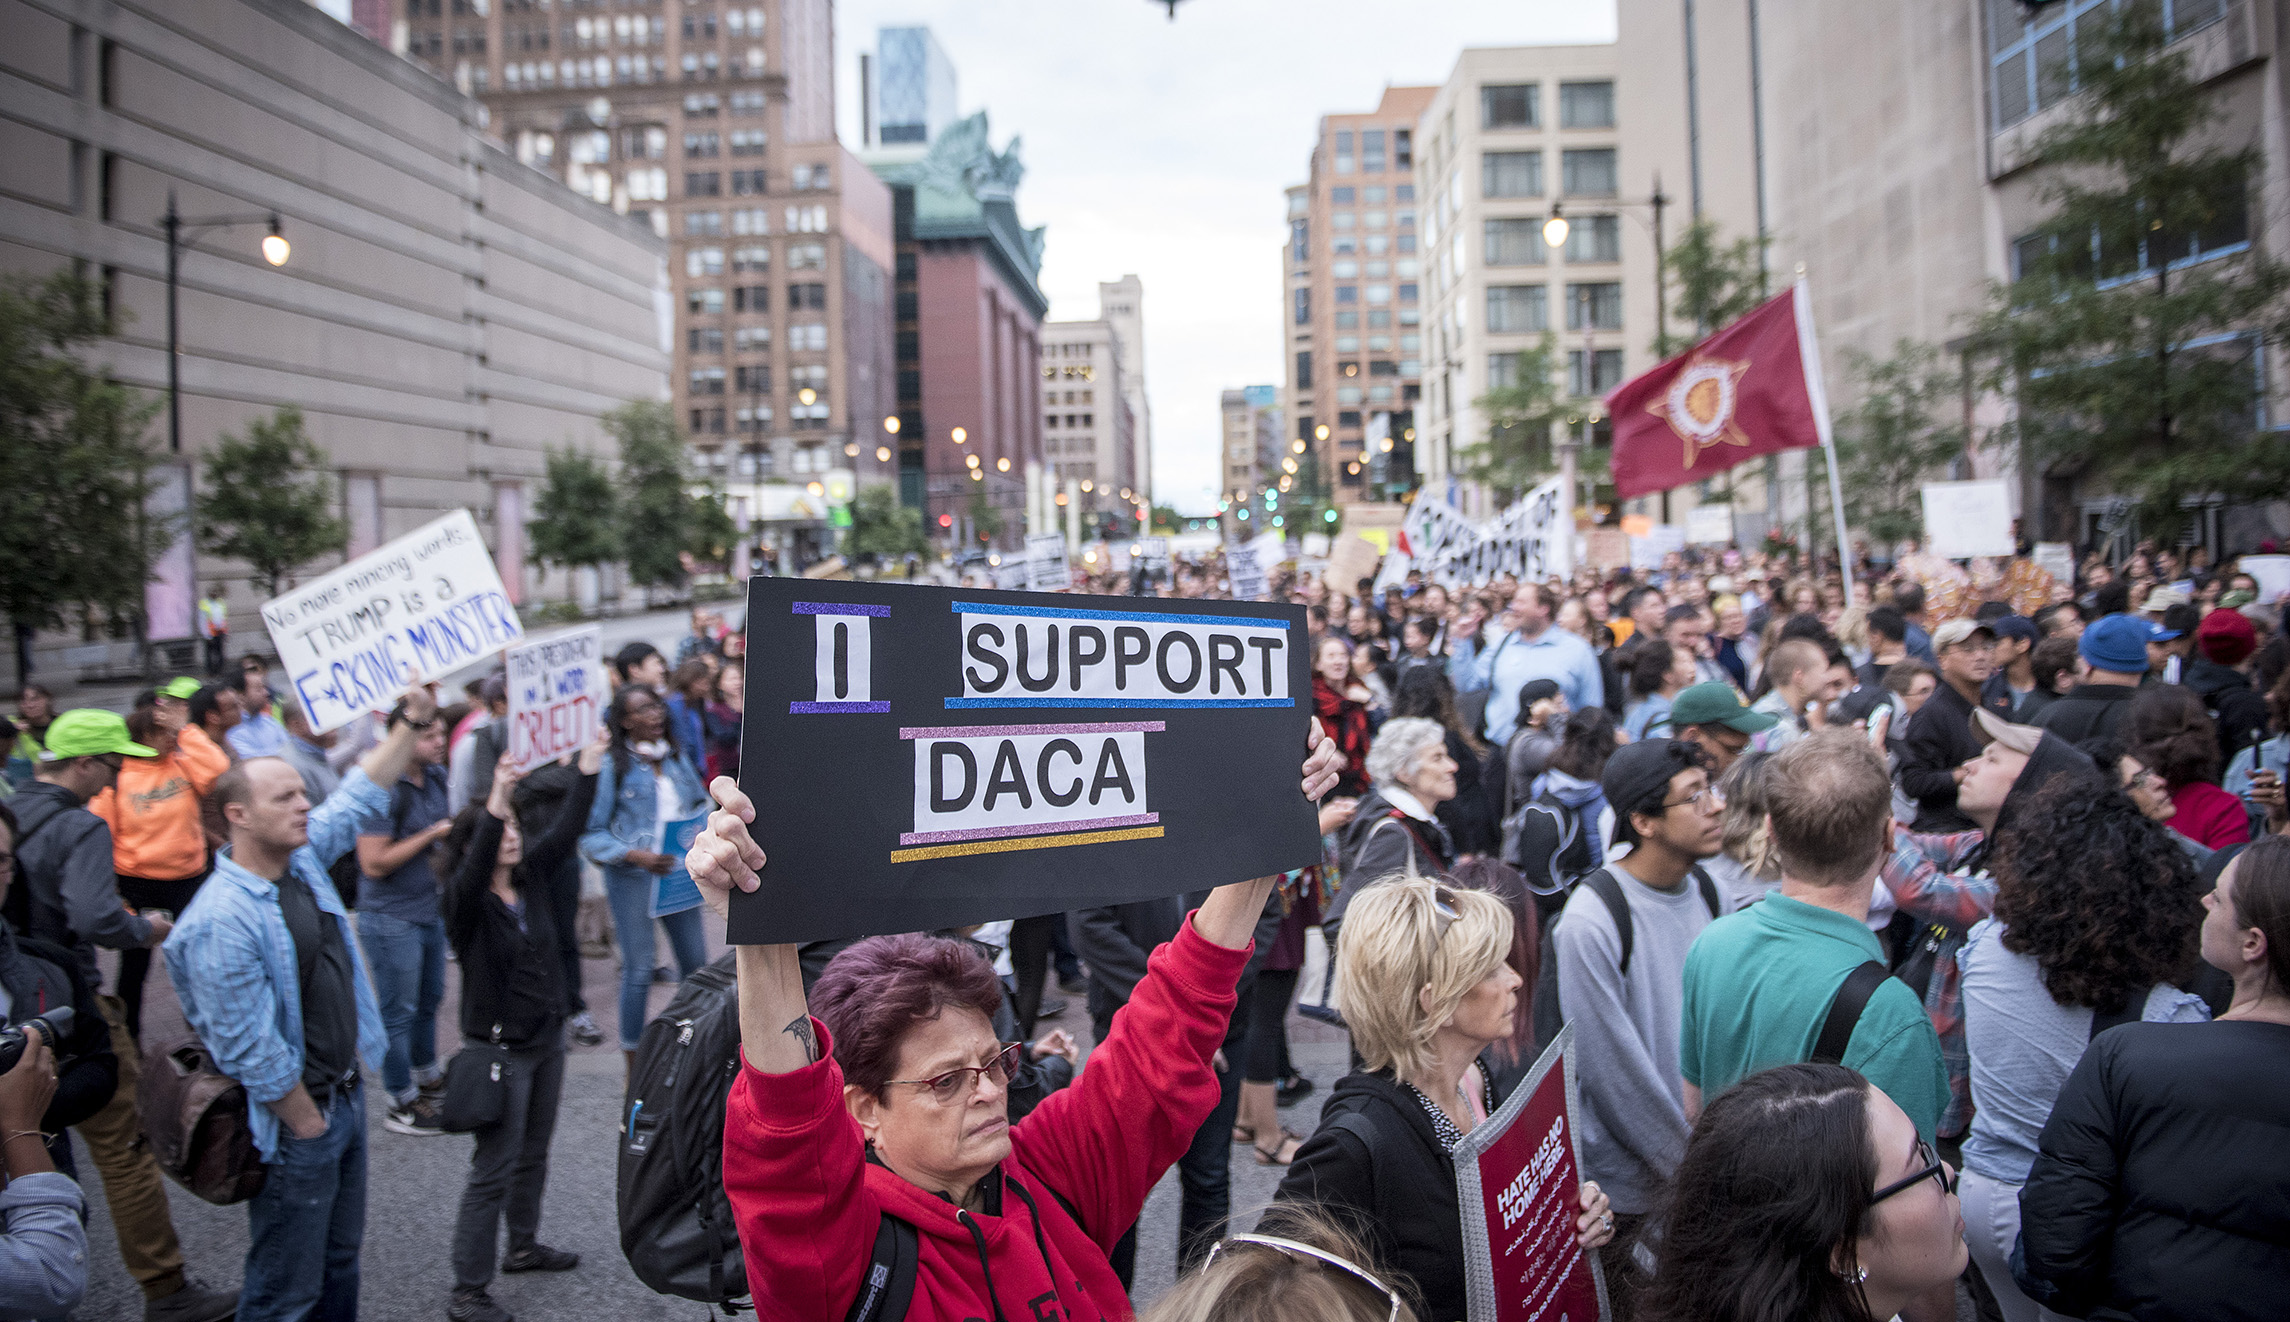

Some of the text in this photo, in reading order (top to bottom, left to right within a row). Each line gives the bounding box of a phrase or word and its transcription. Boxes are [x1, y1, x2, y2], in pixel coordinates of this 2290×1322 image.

[263, 607, 297, 635] No
[299, 586, 342, 617] more
[345, 554, 415, 597] mincing
[295, 576, 456, 659] TRUMP is a
[405, 591, 521, 674] MONSTER
[833, 622, 1284, 700] I SUPPORT
[930, 737, 1136, 814] DACA
[1497, 1165, 1531, 1213] HATE
[1529, 1136, 1551, 1177] HAS
[1548, 1115, 1564, 1148] NO
[1503, 1174, 1541, 1231] HOME
